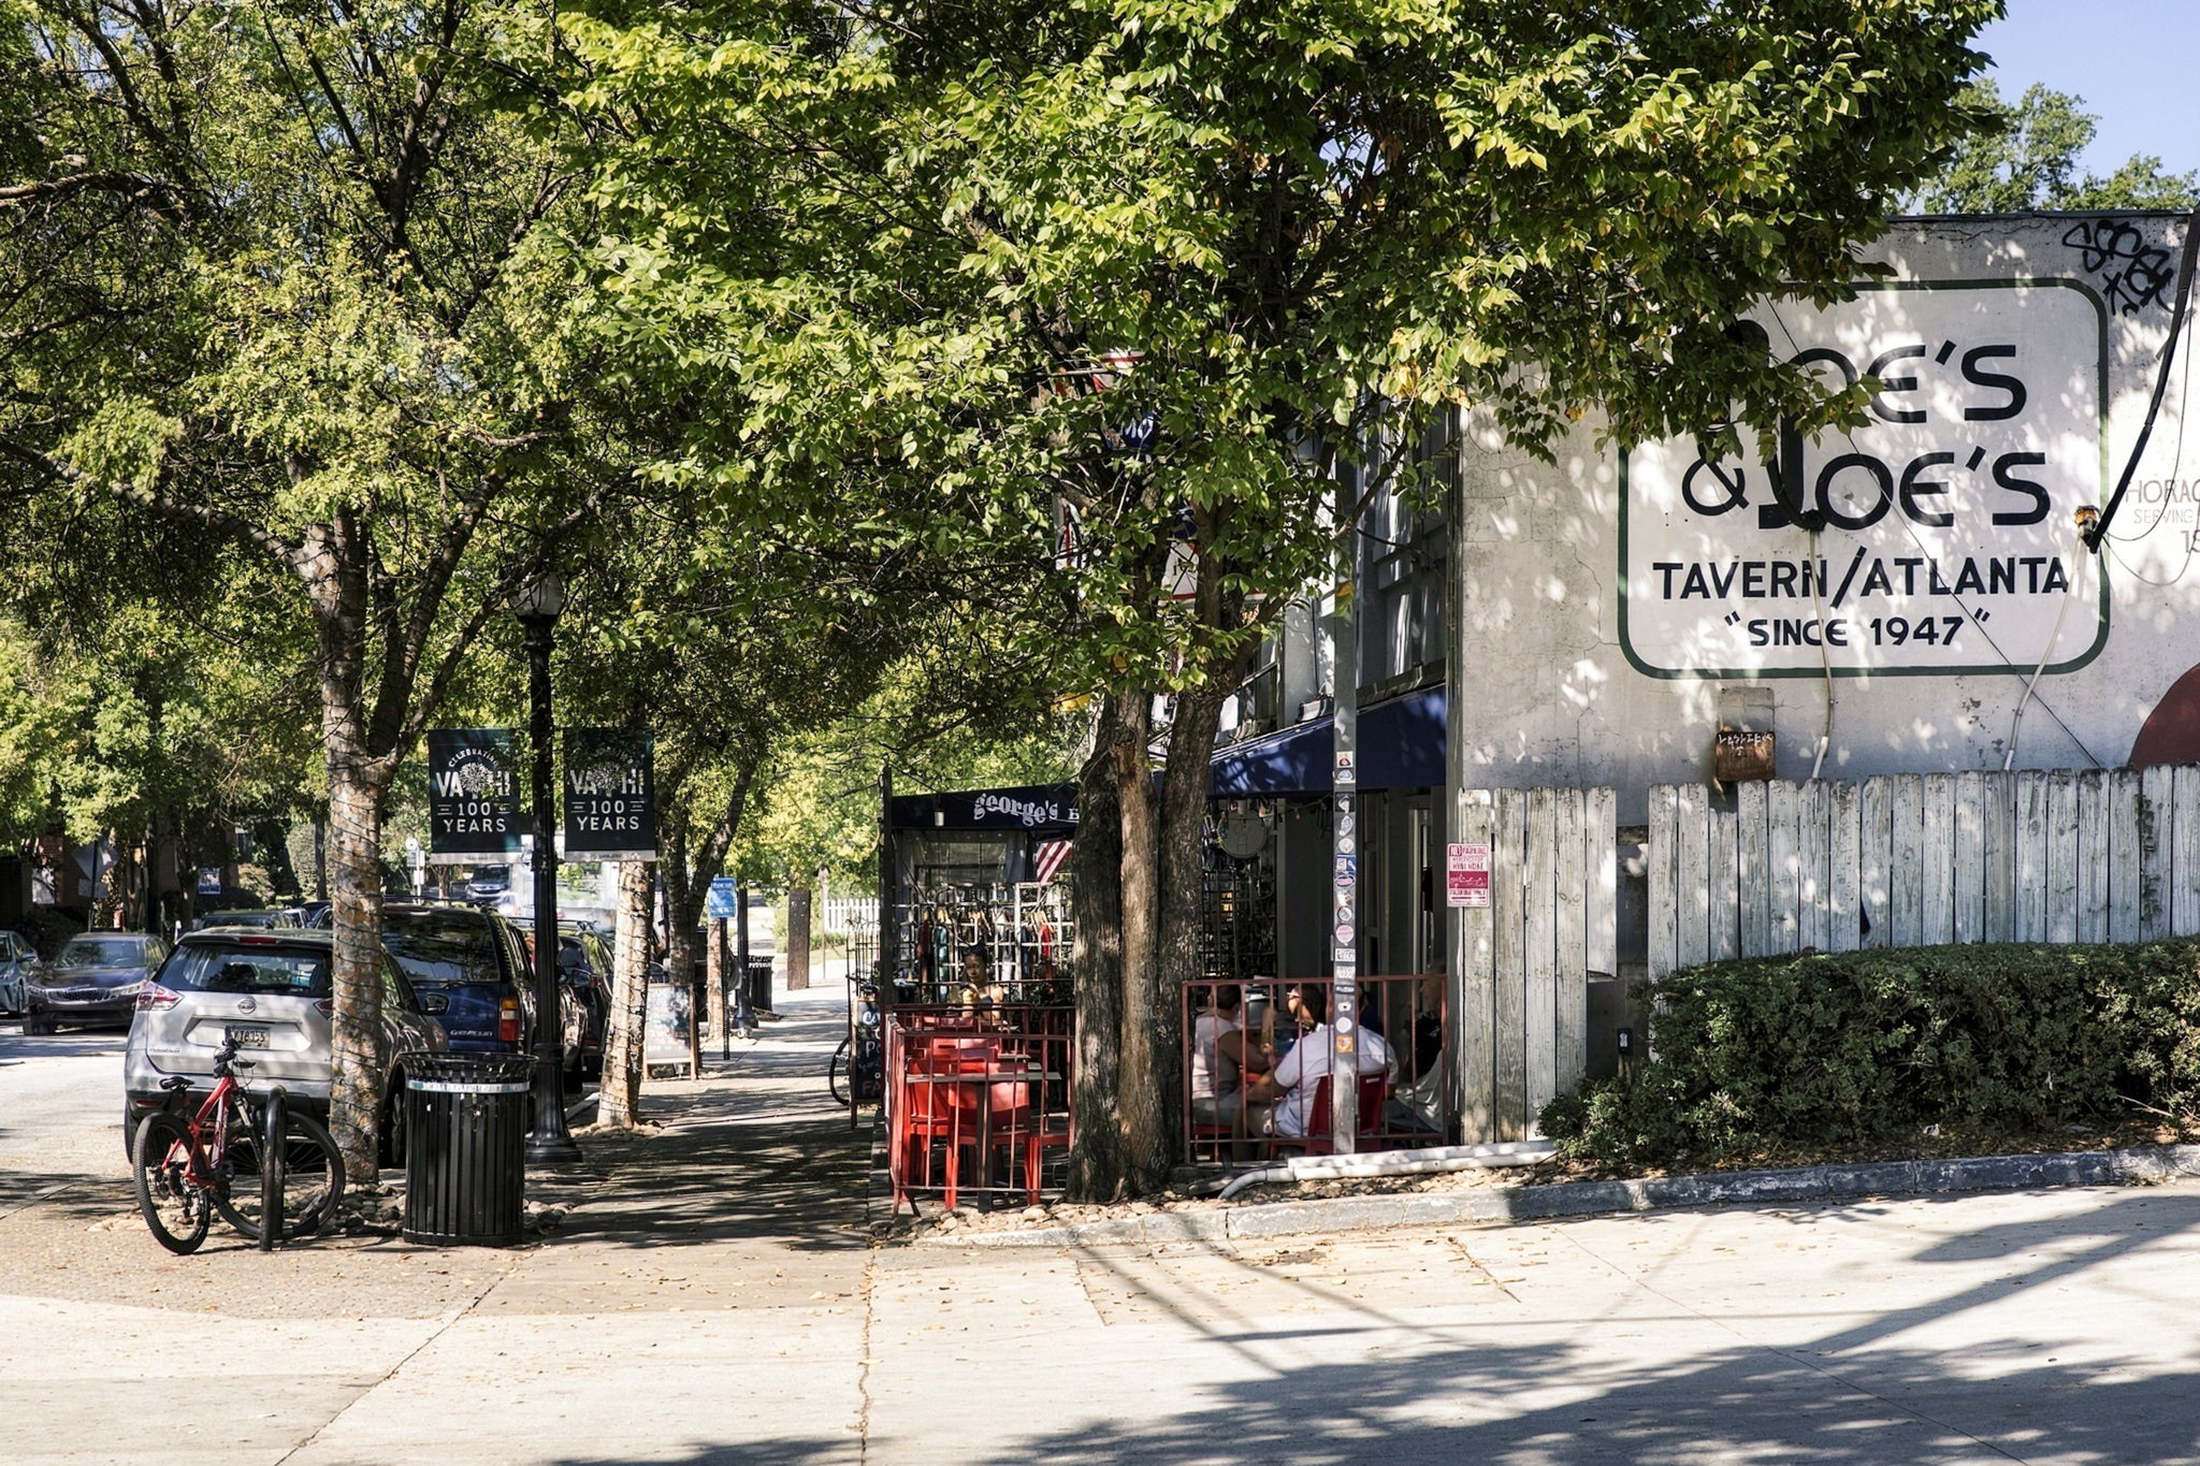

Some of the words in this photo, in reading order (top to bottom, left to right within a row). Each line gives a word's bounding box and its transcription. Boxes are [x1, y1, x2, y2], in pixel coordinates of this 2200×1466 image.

[1758, 410, 2050, 530] JOE'S
[458, 801, 491, 816] 100
[591, 800, 625, 815] 100
[973, 792, 1059, 828] george's
[443, 818, 507, 833] YEARS
[576, 816, 640, 831] YEARS
